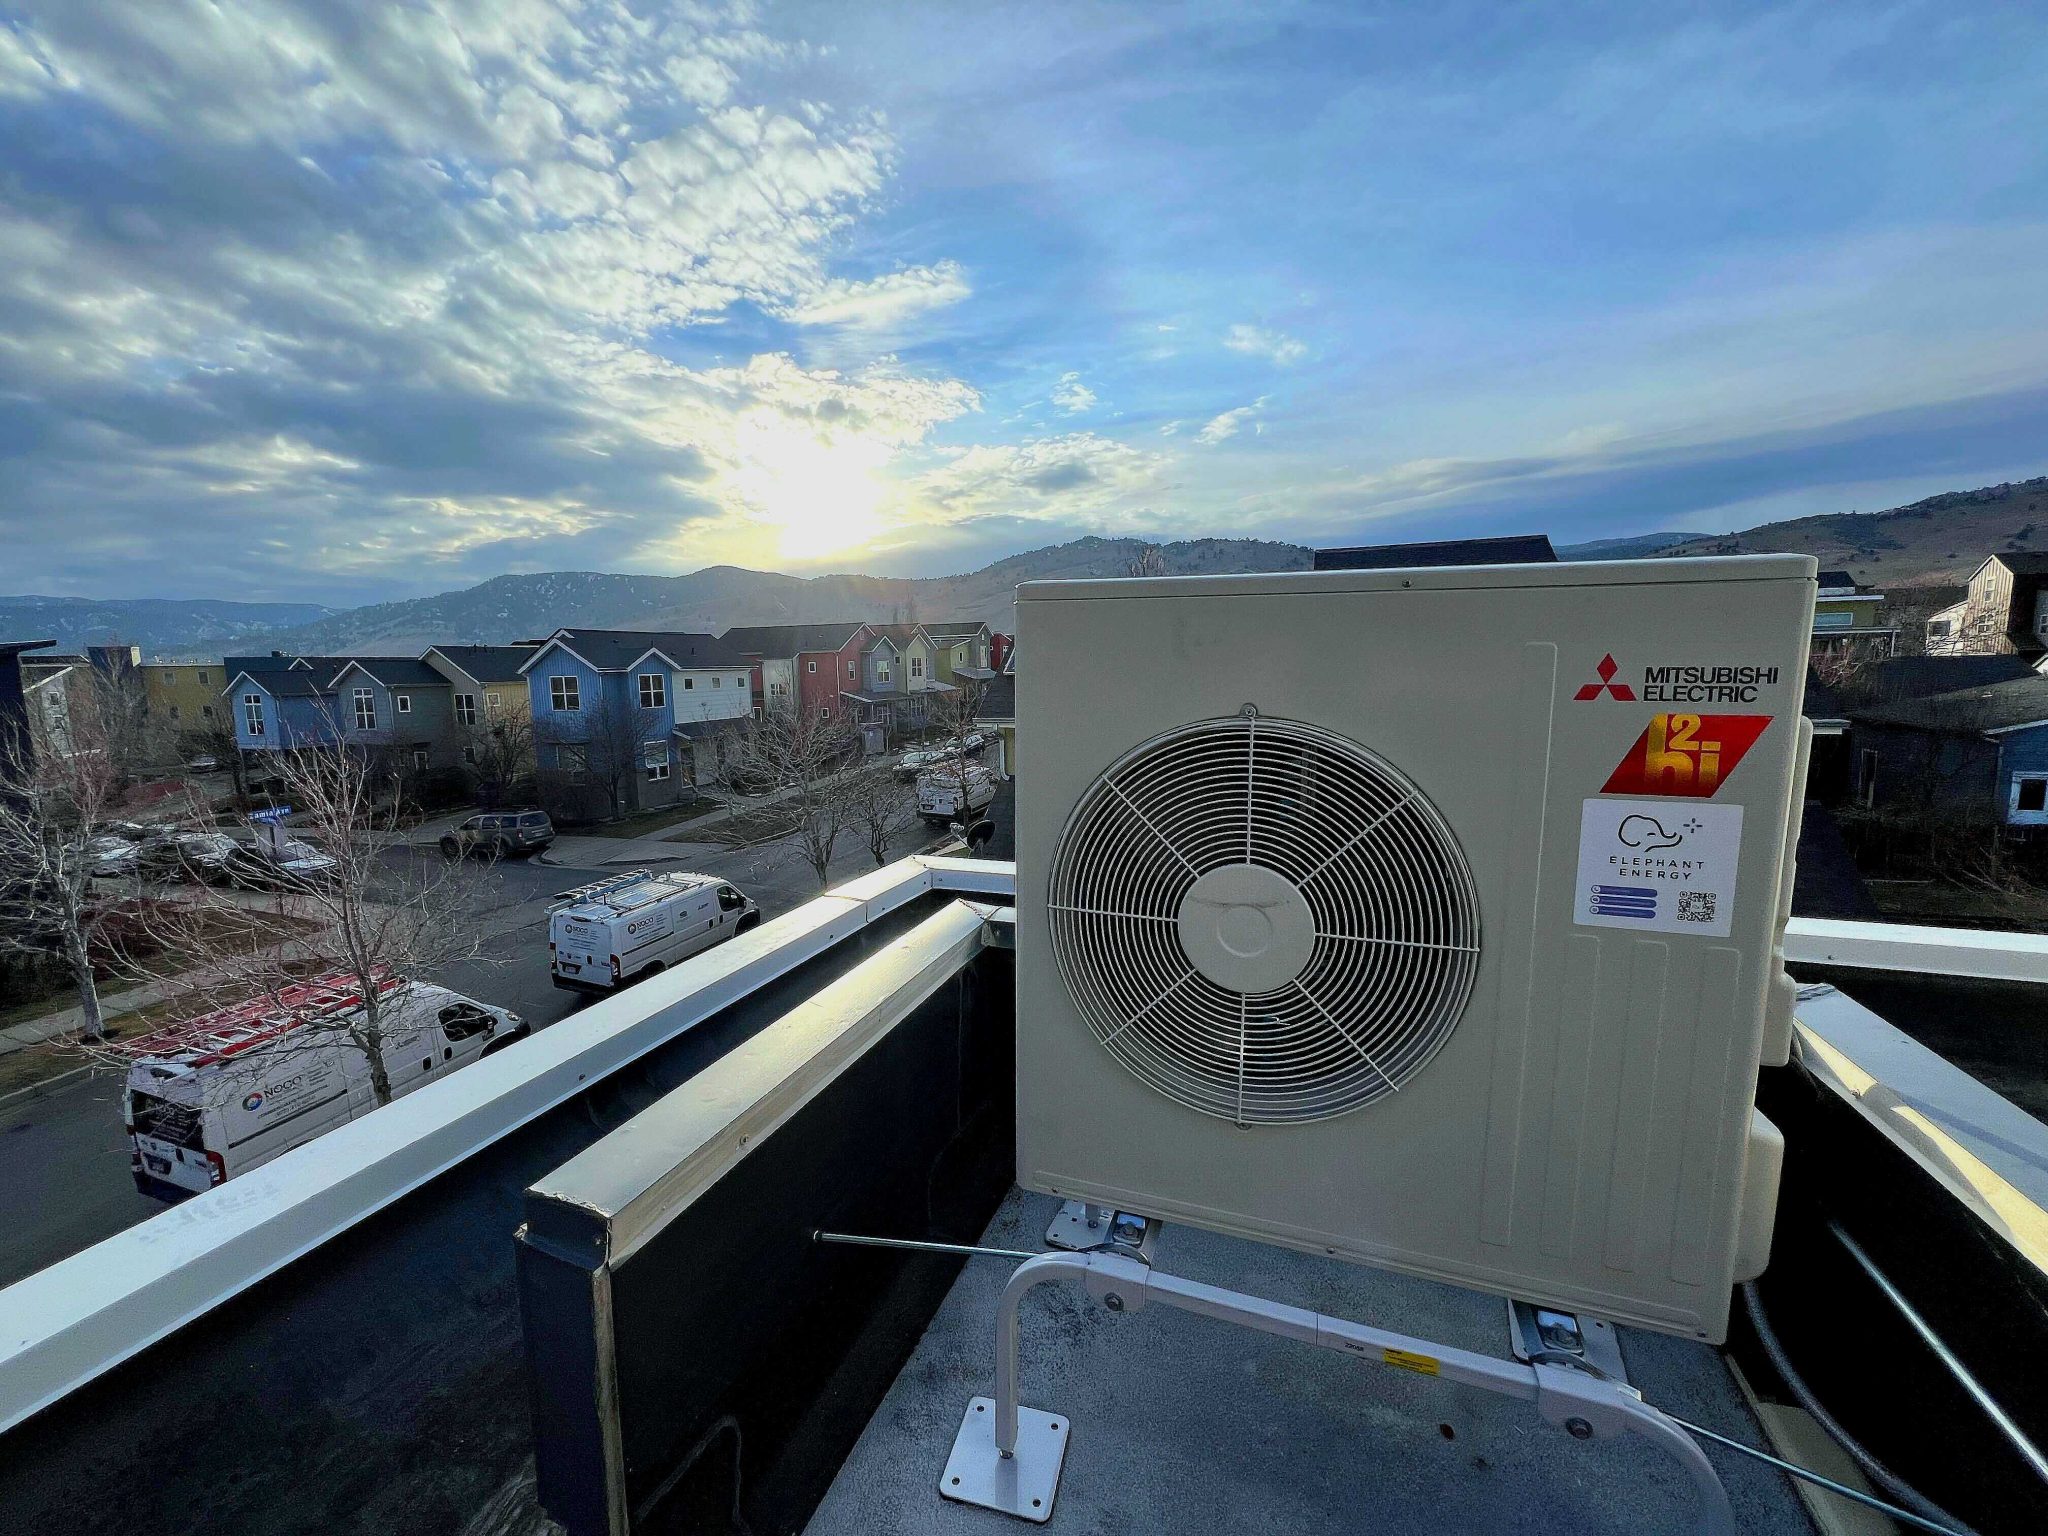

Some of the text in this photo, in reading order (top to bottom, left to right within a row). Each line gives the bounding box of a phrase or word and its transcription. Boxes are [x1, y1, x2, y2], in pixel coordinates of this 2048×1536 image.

[1644, 666, 1780, 684] MITSUBISHI
[1643, 685, 1758, 703] ELECTRIC
[1609, 856, 1705, 869] ELEPHANT
[1619, 868, 1692, 880] ENERGY
[636, 916, 654, 928] NOCO
[264, 1076, 302, 1098] NOCO
